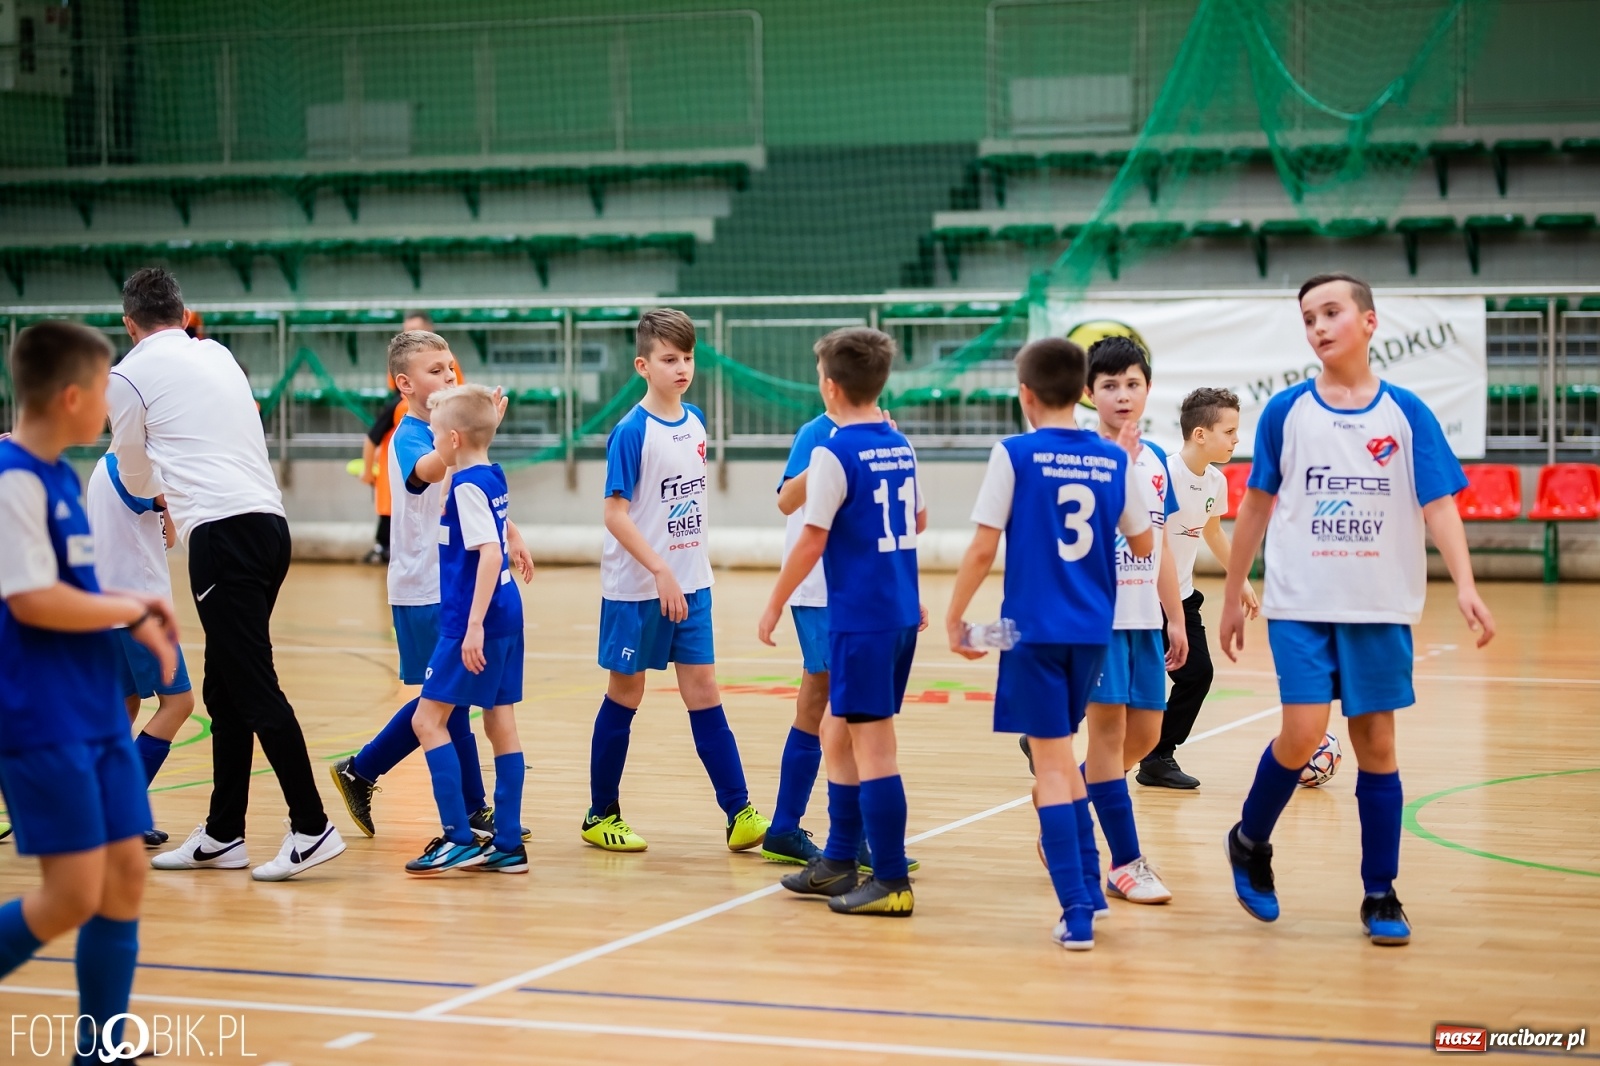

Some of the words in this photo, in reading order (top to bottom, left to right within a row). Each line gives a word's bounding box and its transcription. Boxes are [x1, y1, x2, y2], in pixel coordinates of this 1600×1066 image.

[1247, 378, 1275, 405] W
[1033, 452, 1055, 464] MKP
[1055, 453, 1082, 466] ODRA
[873, 476, 917, 553] 11
[1056, 483, 1096, 562] 3
[1311, 519, 1383, 535] ENERGY
